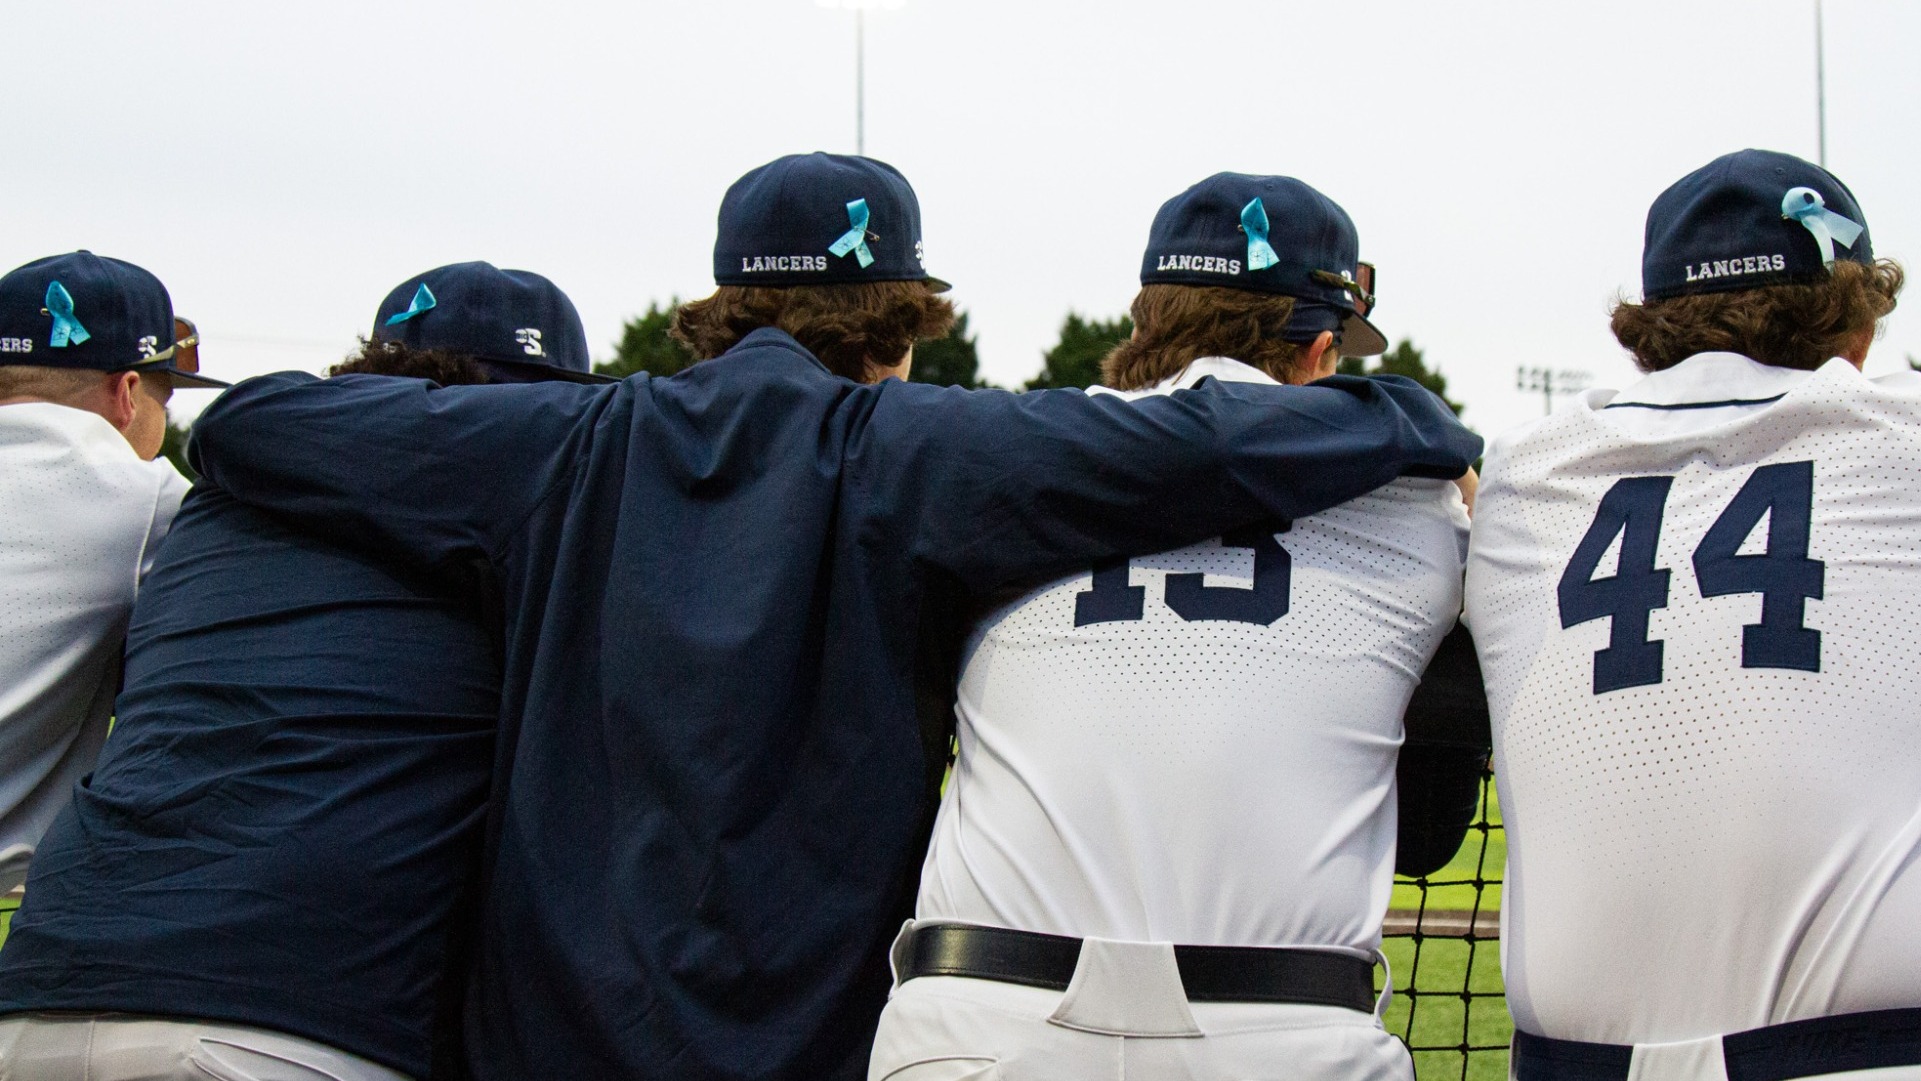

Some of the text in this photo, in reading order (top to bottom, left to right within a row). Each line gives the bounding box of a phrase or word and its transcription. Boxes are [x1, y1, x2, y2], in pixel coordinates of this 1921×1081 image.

[741, 255, 828, 272] LANCERS
[1156, 254, 1242, 276] LANCERS
[1685, 253, 1786, 282] LANCERS
[0, 336, 33, 354] ERS
[1557, 460, 1826, 696] 44
